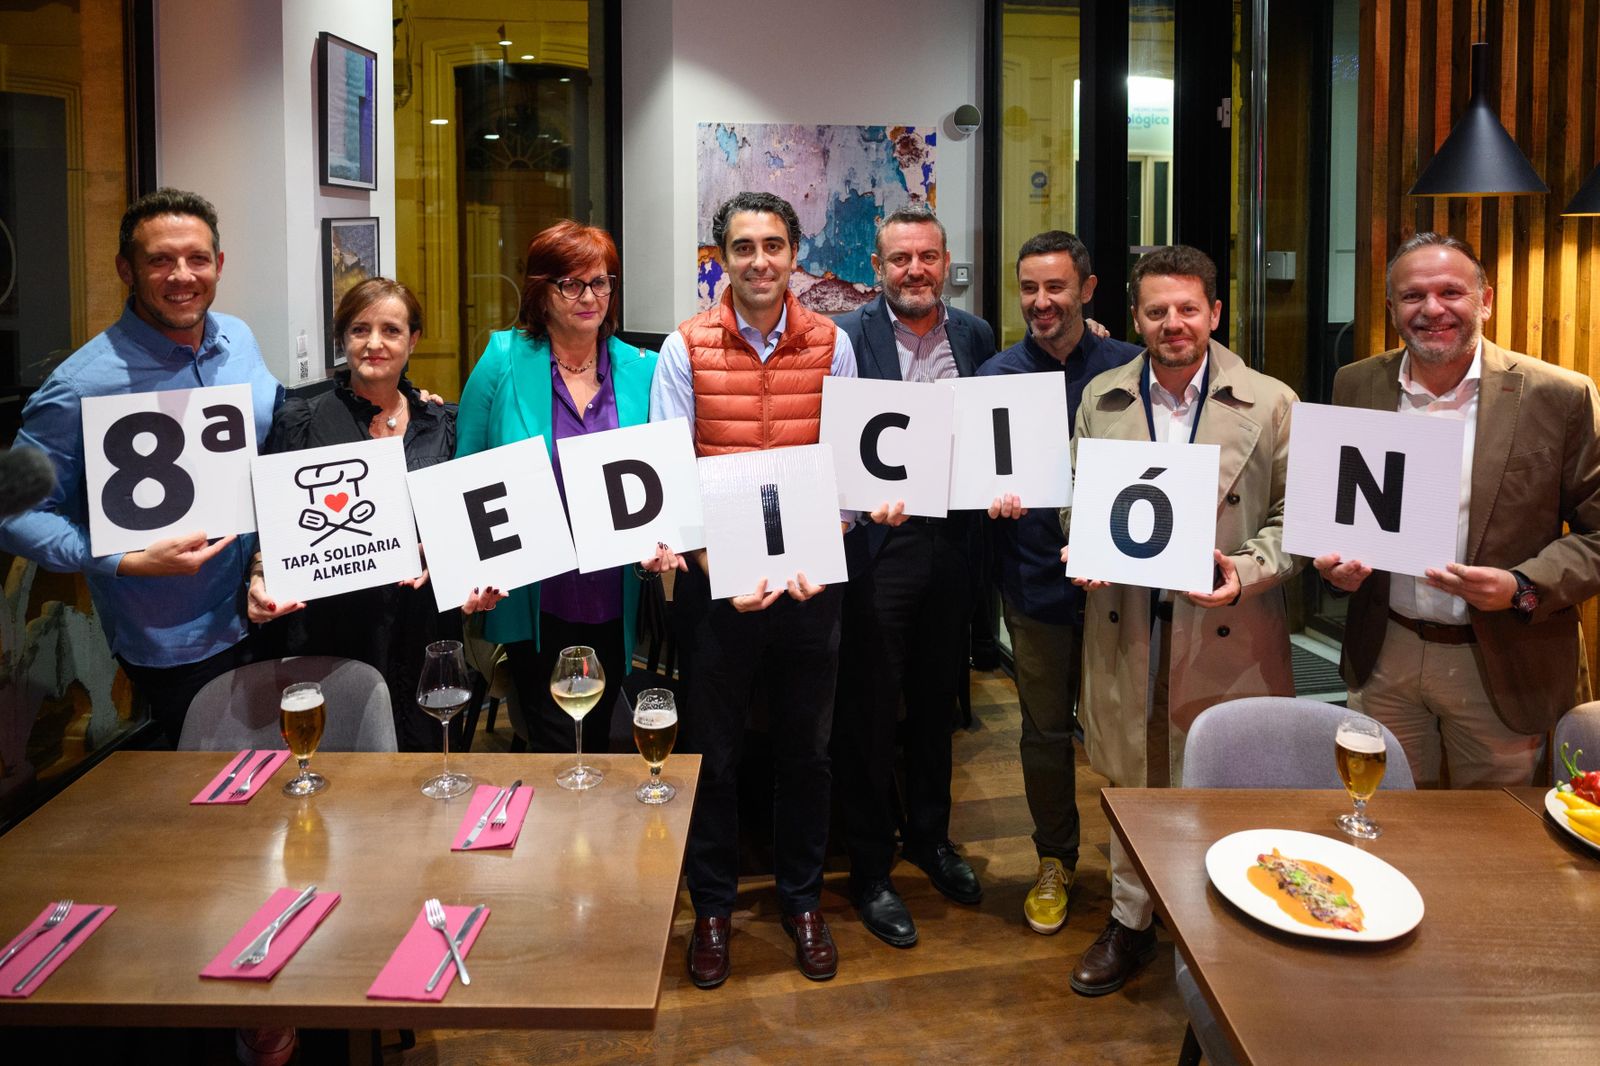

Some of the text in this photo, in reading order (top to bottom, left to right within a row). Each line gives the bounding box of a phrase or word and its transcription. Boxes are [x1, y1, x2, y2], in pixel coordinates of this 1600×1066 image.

[859, 412, 911, 482] C
[991, 407, 1013, 476] I
[462, 481, 523, 562] E
[602, 459, 664, 531] D
[760, 483, 786, 556] I
[1109, 467, 1174, 559] Ó
[1334, 445, 1406, 534] N
[281, 537, 401, 570] TAPA SOLIDARIA
[312, 558, 377, 582] ALMERIA
